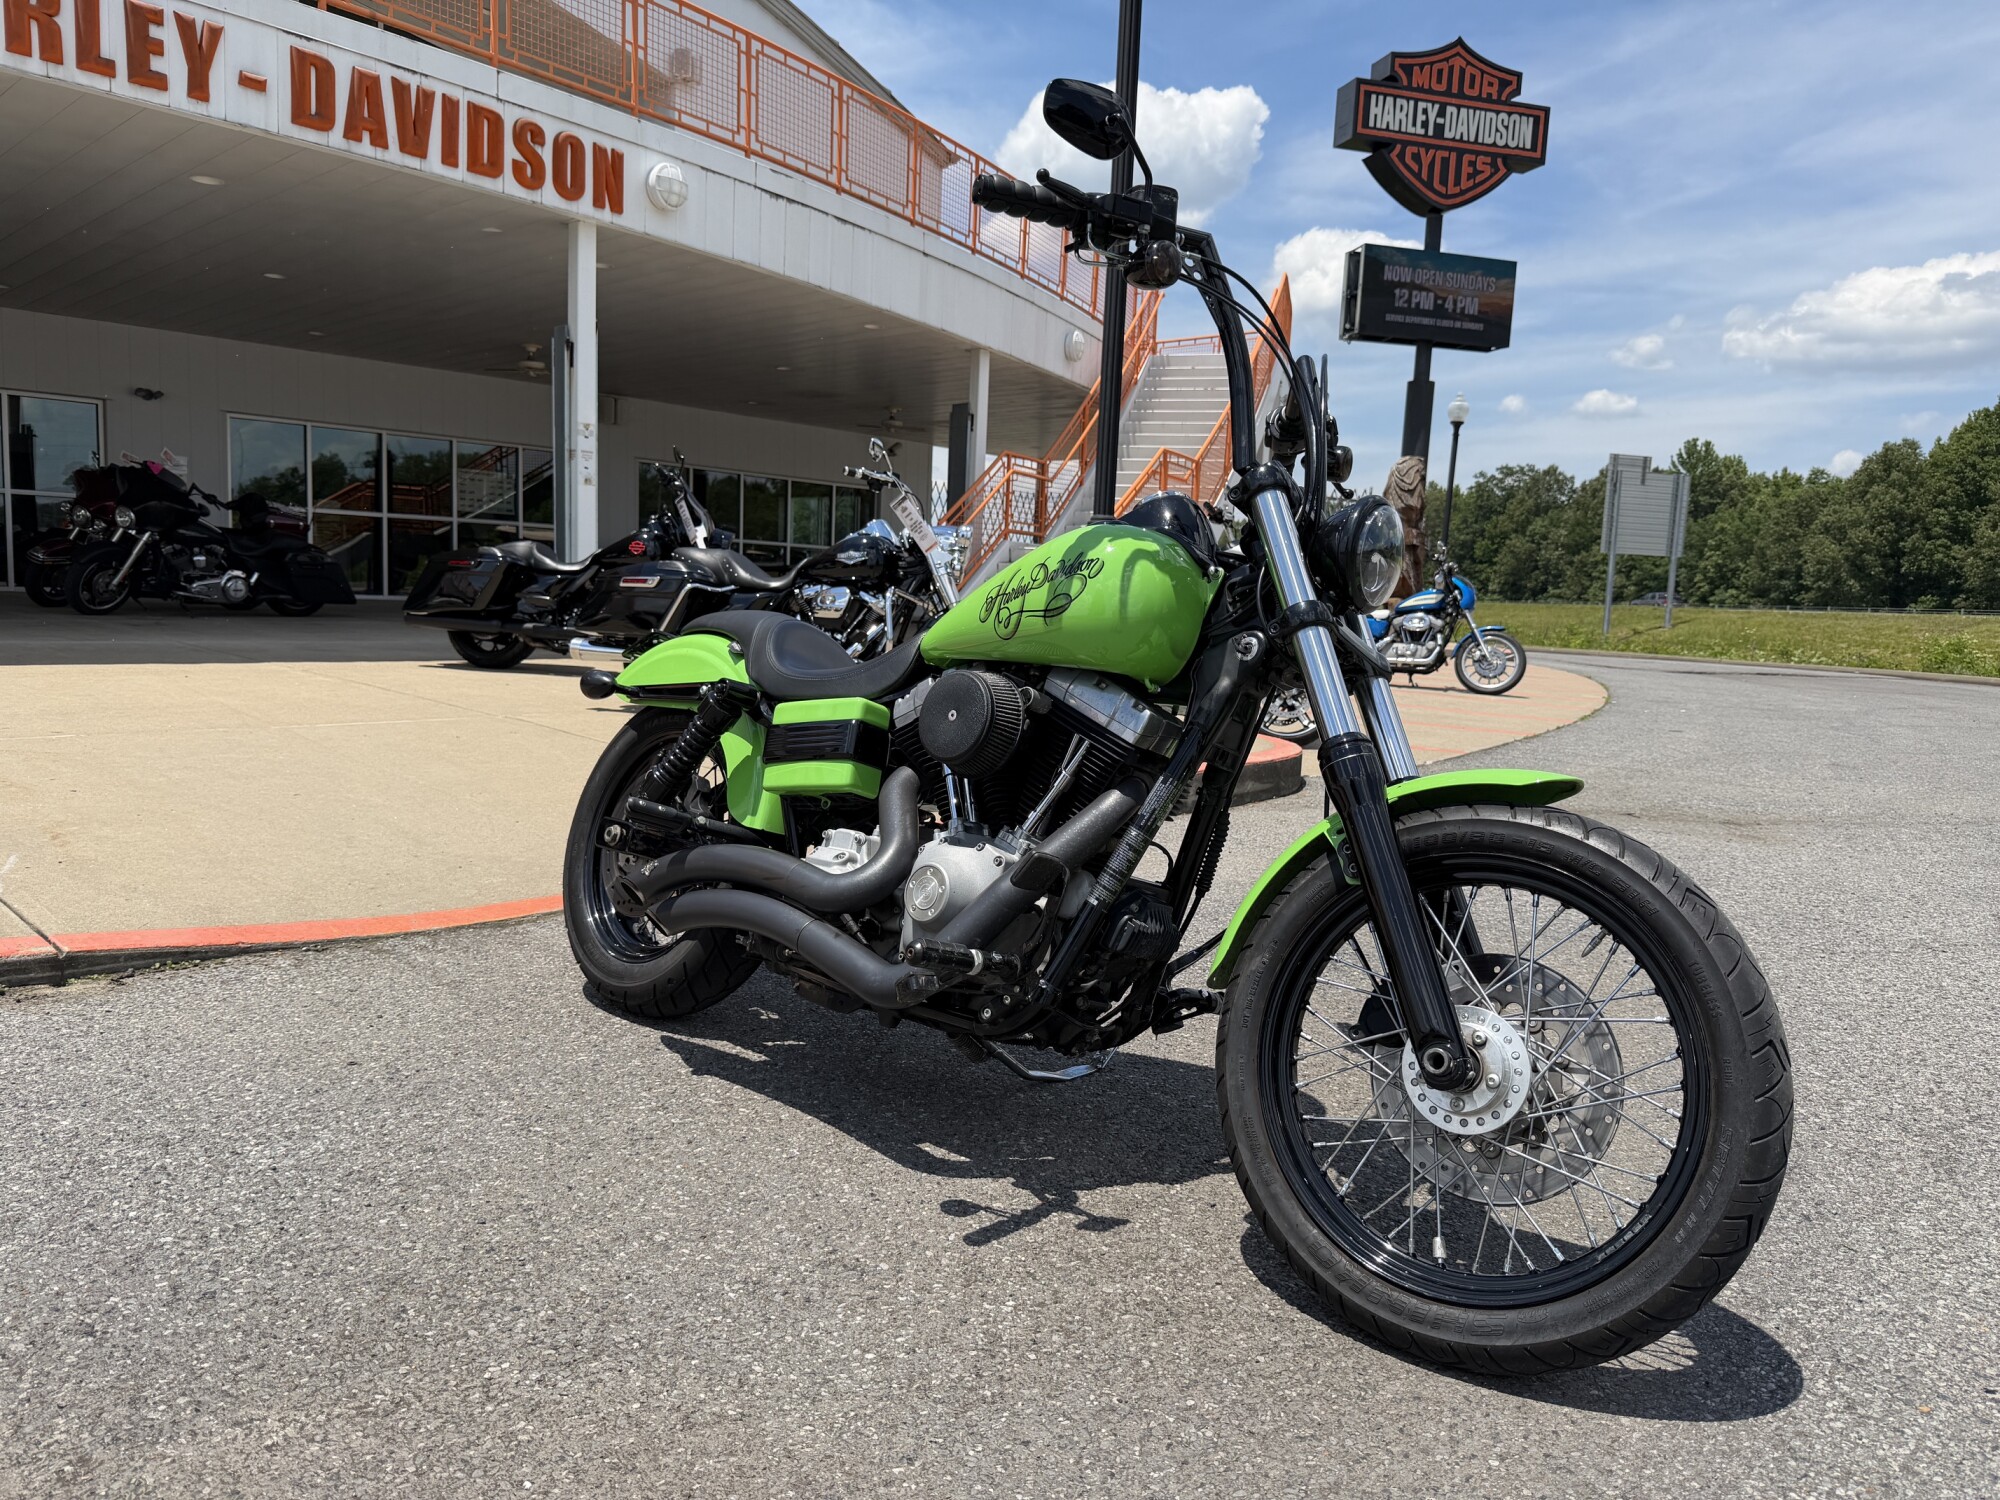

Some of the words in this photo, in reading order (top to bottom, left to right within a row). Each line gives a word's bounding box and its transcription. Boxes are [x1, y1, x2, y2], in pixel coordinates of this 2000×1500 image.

[1412, 56, 1499, 100] MOTOR
[1368, 94, 1534, 149] HARLEY-DAVIDSON
[1404, 145, 1492, 194] CYCLES
[1383, 264, 1413, 283] NOW
[1415, 268, 1444, 287] OPEN
[1446, 272, 1496, 292] SUNDAYS
[1394, 288, 1408, 308] 12
[1411, 290, 1434, 311] PM
[1444, 294, 1454, 313] 4
[1456, 296, 1479, 315] PM
